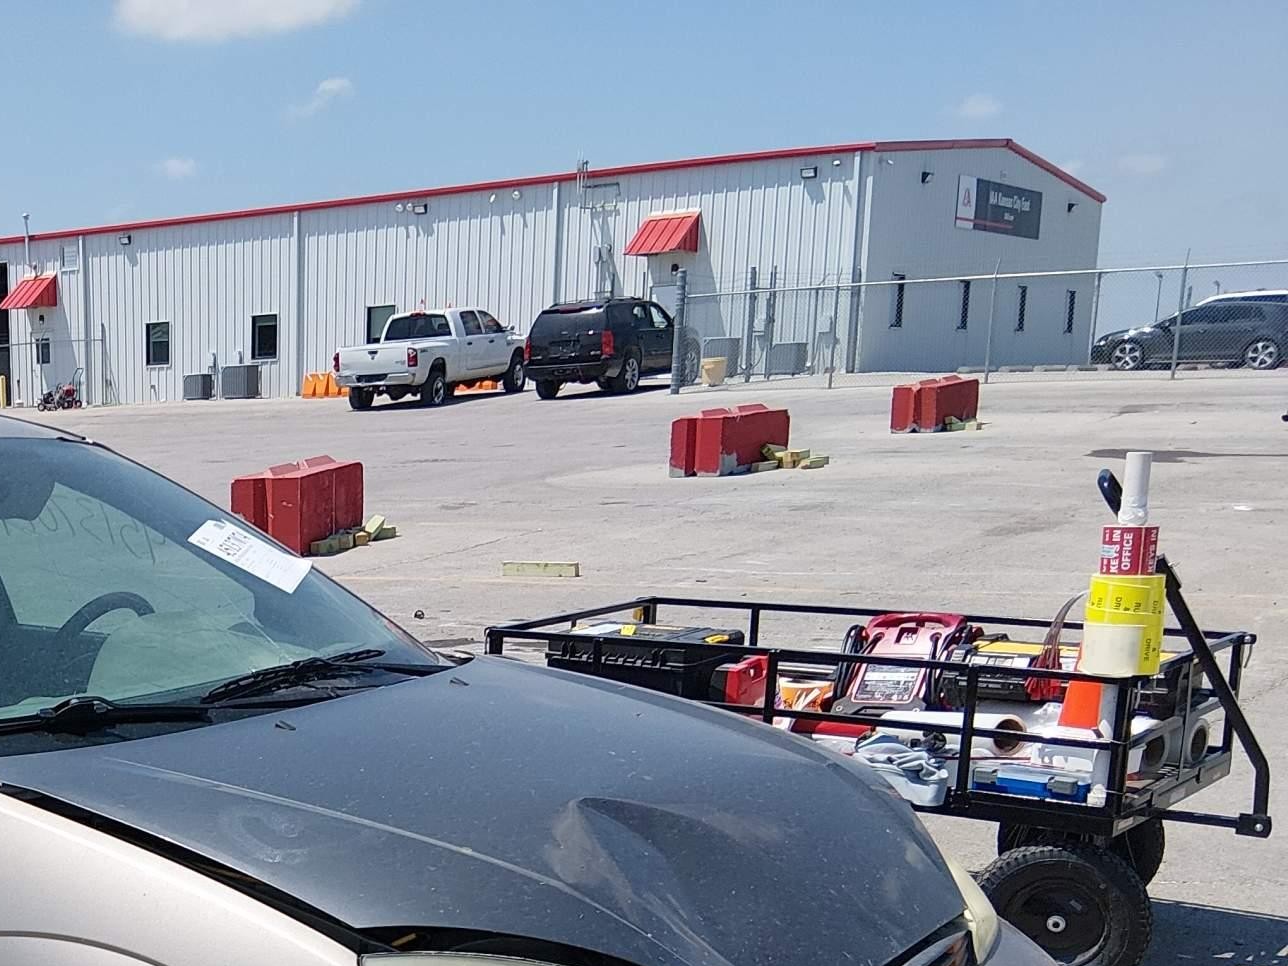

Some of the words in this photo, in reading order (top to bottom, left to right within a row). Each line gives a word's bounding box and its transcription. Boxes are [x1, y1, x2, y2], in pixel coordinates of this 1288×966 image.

[1112, 529, 1121, 541] IN
[1109, 545, 1120, 573] KEYS
[1121, 532, 1134, 571] OFFICE
[1143, 638, 1152, 662] DRIVE
